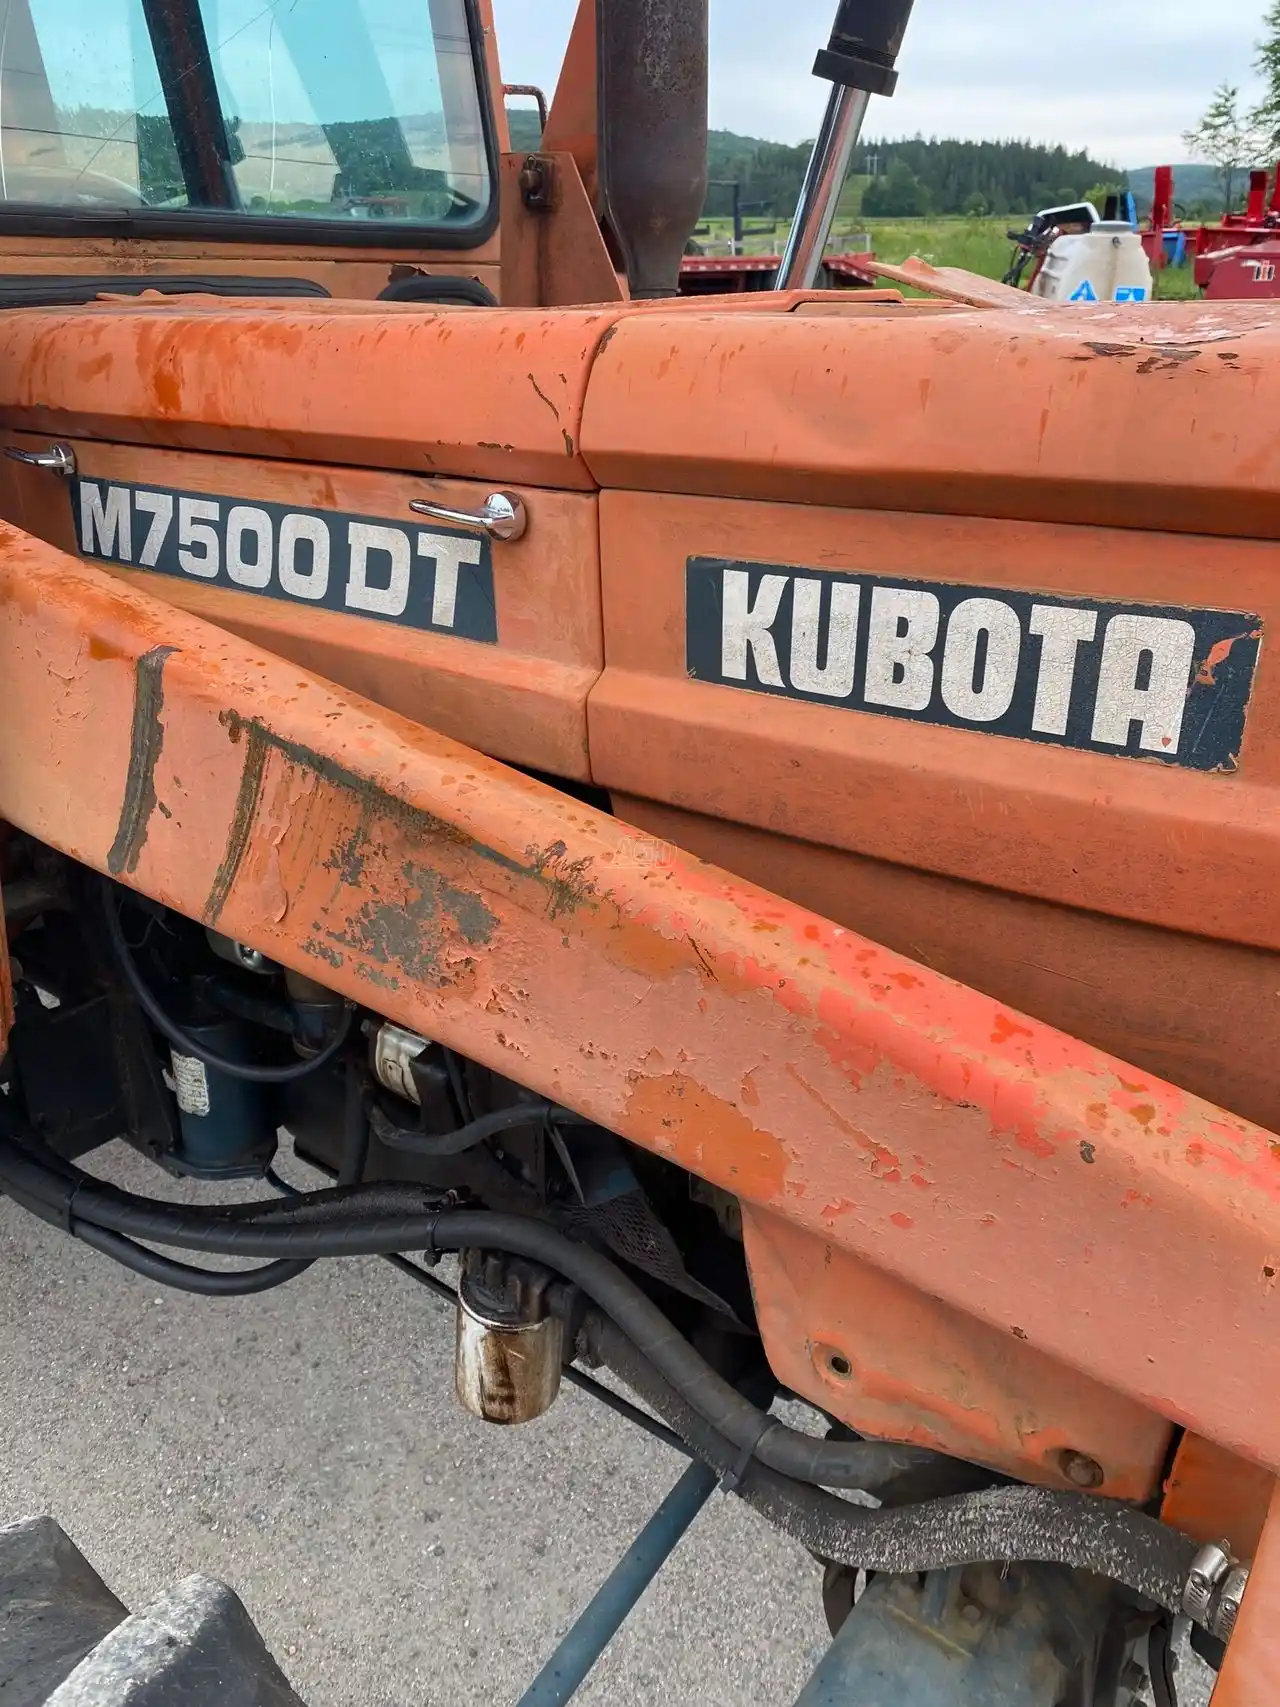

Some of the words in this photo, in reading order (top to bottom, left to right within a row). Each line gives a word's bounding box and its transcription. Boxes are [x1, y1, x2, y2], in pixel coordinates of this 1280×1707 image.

[79, 481, 331, 600] M7500
[345, 521, 482, 628] DT
[721, 569, 1196, 755] KUBOTA
